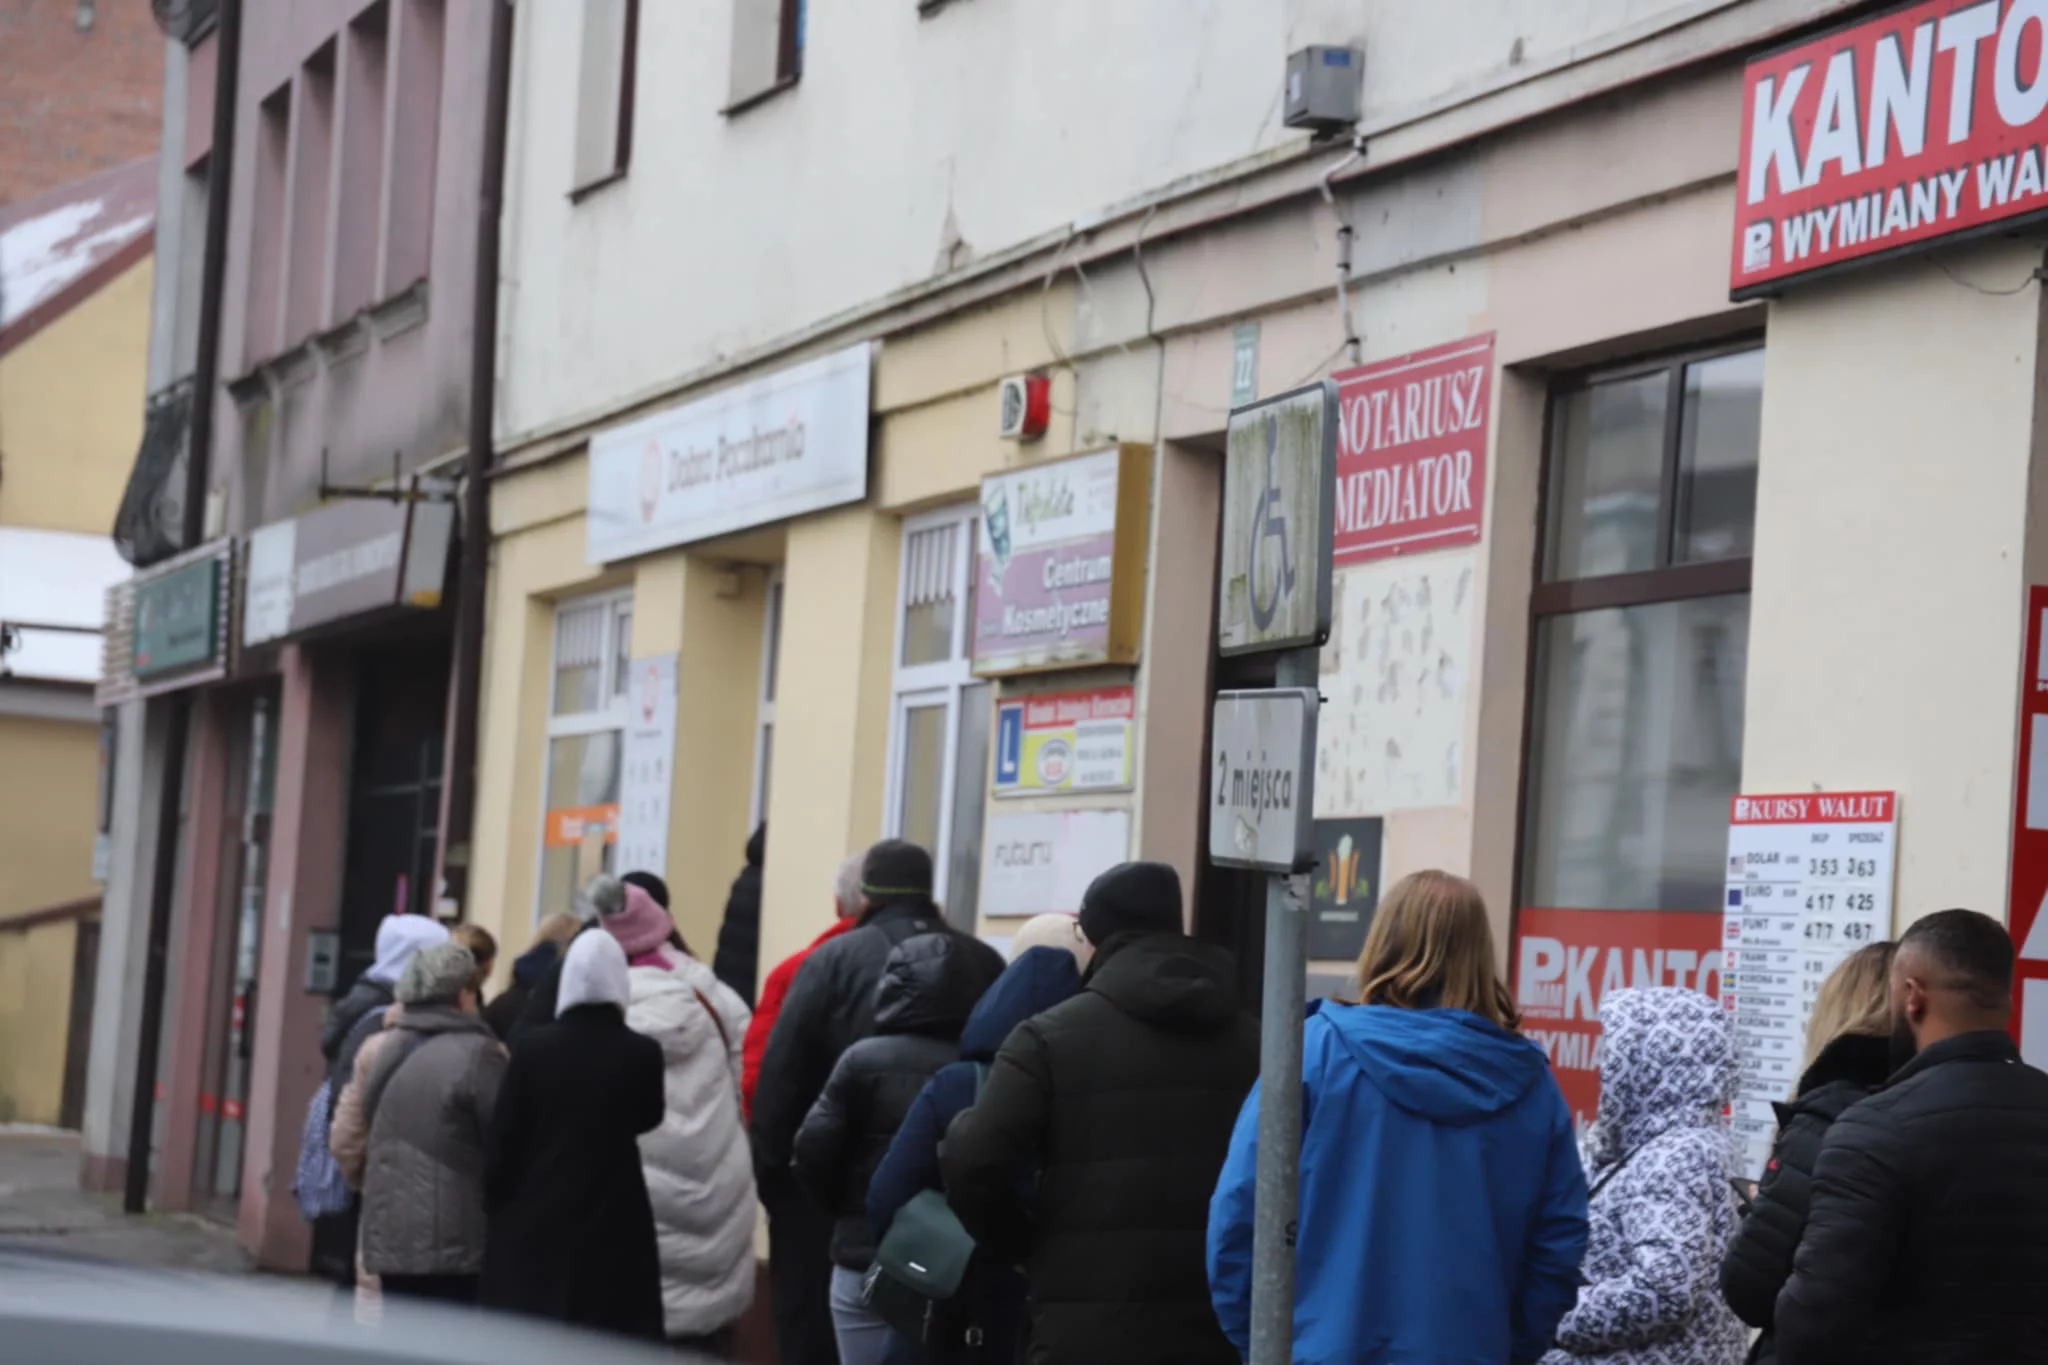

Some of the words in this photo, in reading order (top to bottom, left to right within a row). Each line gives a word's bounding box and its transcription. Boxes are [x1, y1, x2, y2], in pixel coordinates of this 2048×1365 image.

[1747, 0, 2048, 205] KANTO
[1782, 169, 1968, 263] WYMIANY
[1977, 144, 2048, 209] WA
[1339, 365, 1485, 456] NOTARIUSZ
[1335, 449, 1472, 536] MEDIATOR
[1043, 556, 1112, 589] Centrum
[1218, 750, 1227, 806] 2
[1232, 749, 1292, 825] miejsca
[1750, 798, 1810, 820] KURSY
[1818, 796, 1887, 818] WALUT
[1745, 885, 1772, 898] EURO
[1747, 852, 1780, 865] DOLAR
